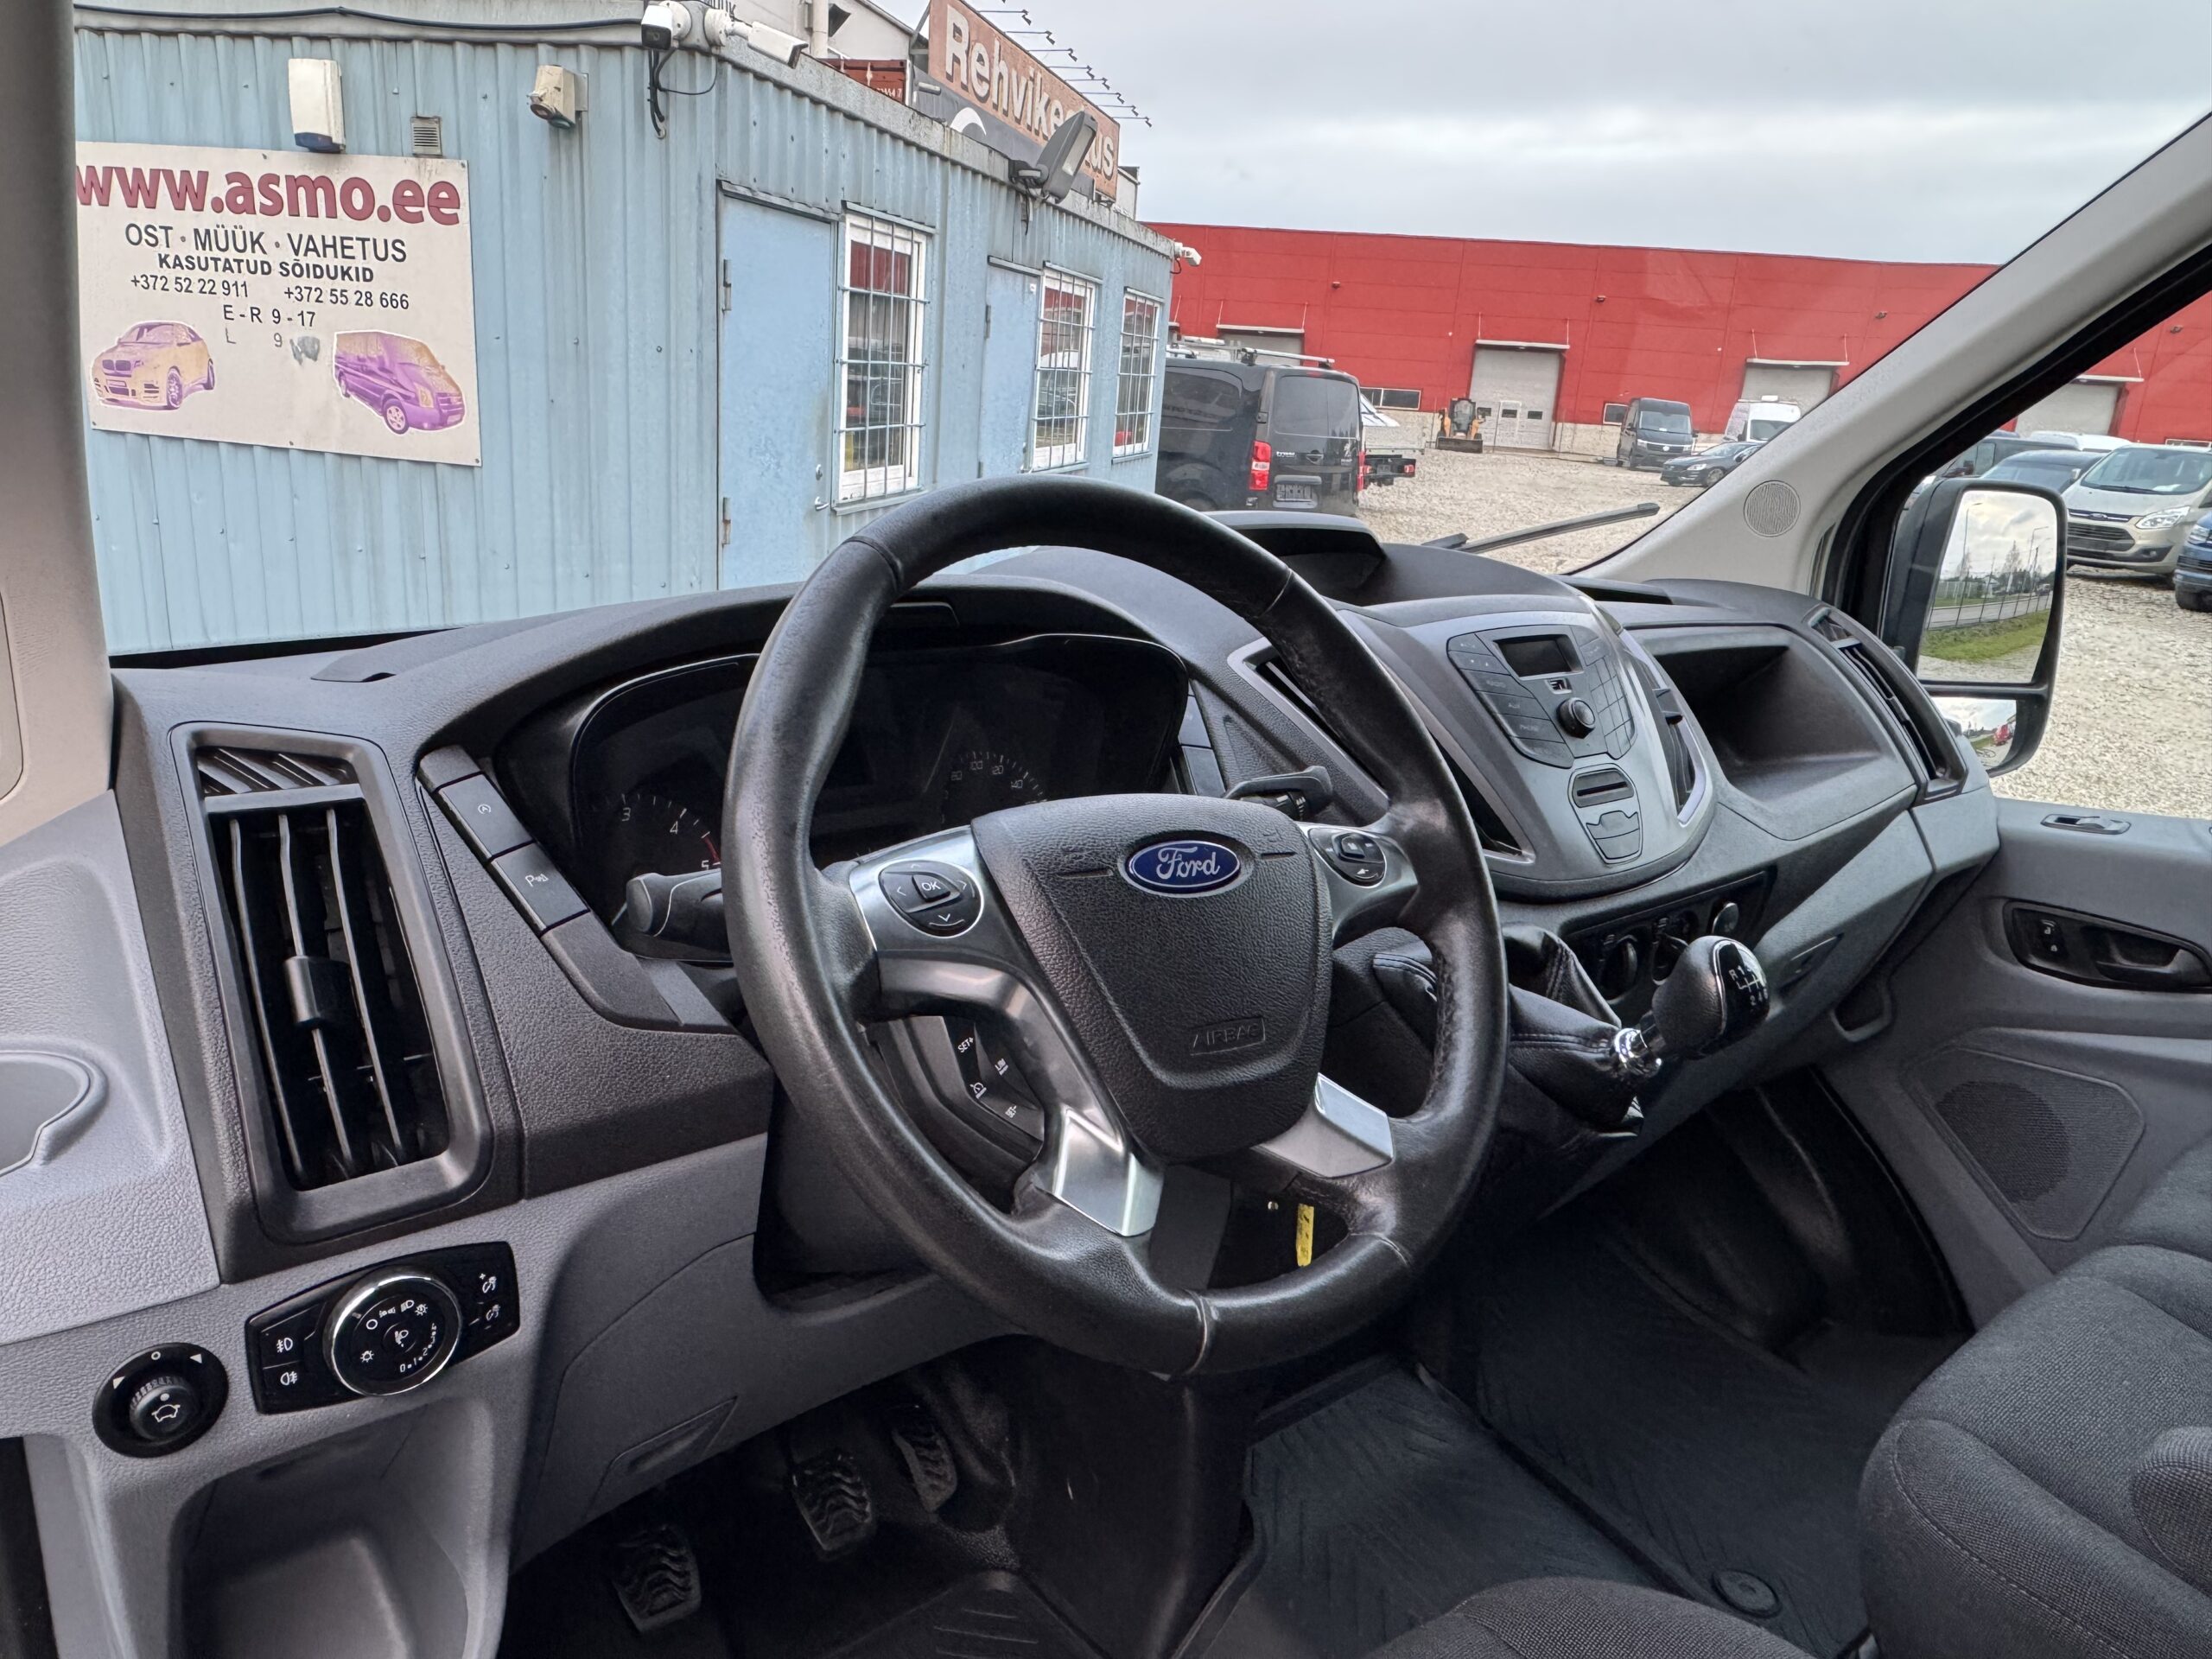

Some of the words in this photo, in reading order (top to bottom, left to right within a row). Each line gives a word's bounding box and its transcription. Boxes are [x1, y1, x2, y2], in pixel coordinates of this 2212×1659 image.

[944, 3, 1115, 179] Rehvikeus
[76, 164, 461, 226] www.asmo.ee
[125, 223, 173, 248] OST
[194, 224, 267, 255] MÜÜK
[287, 232, 407, 263] VAHETUS
[157, 252, 272, 276] KASUTATUD
[279, 258, 374, 283] SÕIDUKID
[130, 274, 169, 291] +372
[174, 276, 193, 294] 52
[197, 278, 216, 296] 22
[221, 280, 249, 298] 911
[283, 286, 323, 303] +372
[329, 289, 349, 306] 55
[354, 290, 373, 308] 28
[379, 291, 410, 309] 666
[621, 807, 632, 822] 3
[669, 820, 678, 835] 4
[1155, 846, 1221, 880] Ford
[921, 880, 942, 892] OK
[1728, 969, 1738, 981] R
[1737, 964, 1745, 976] 1
